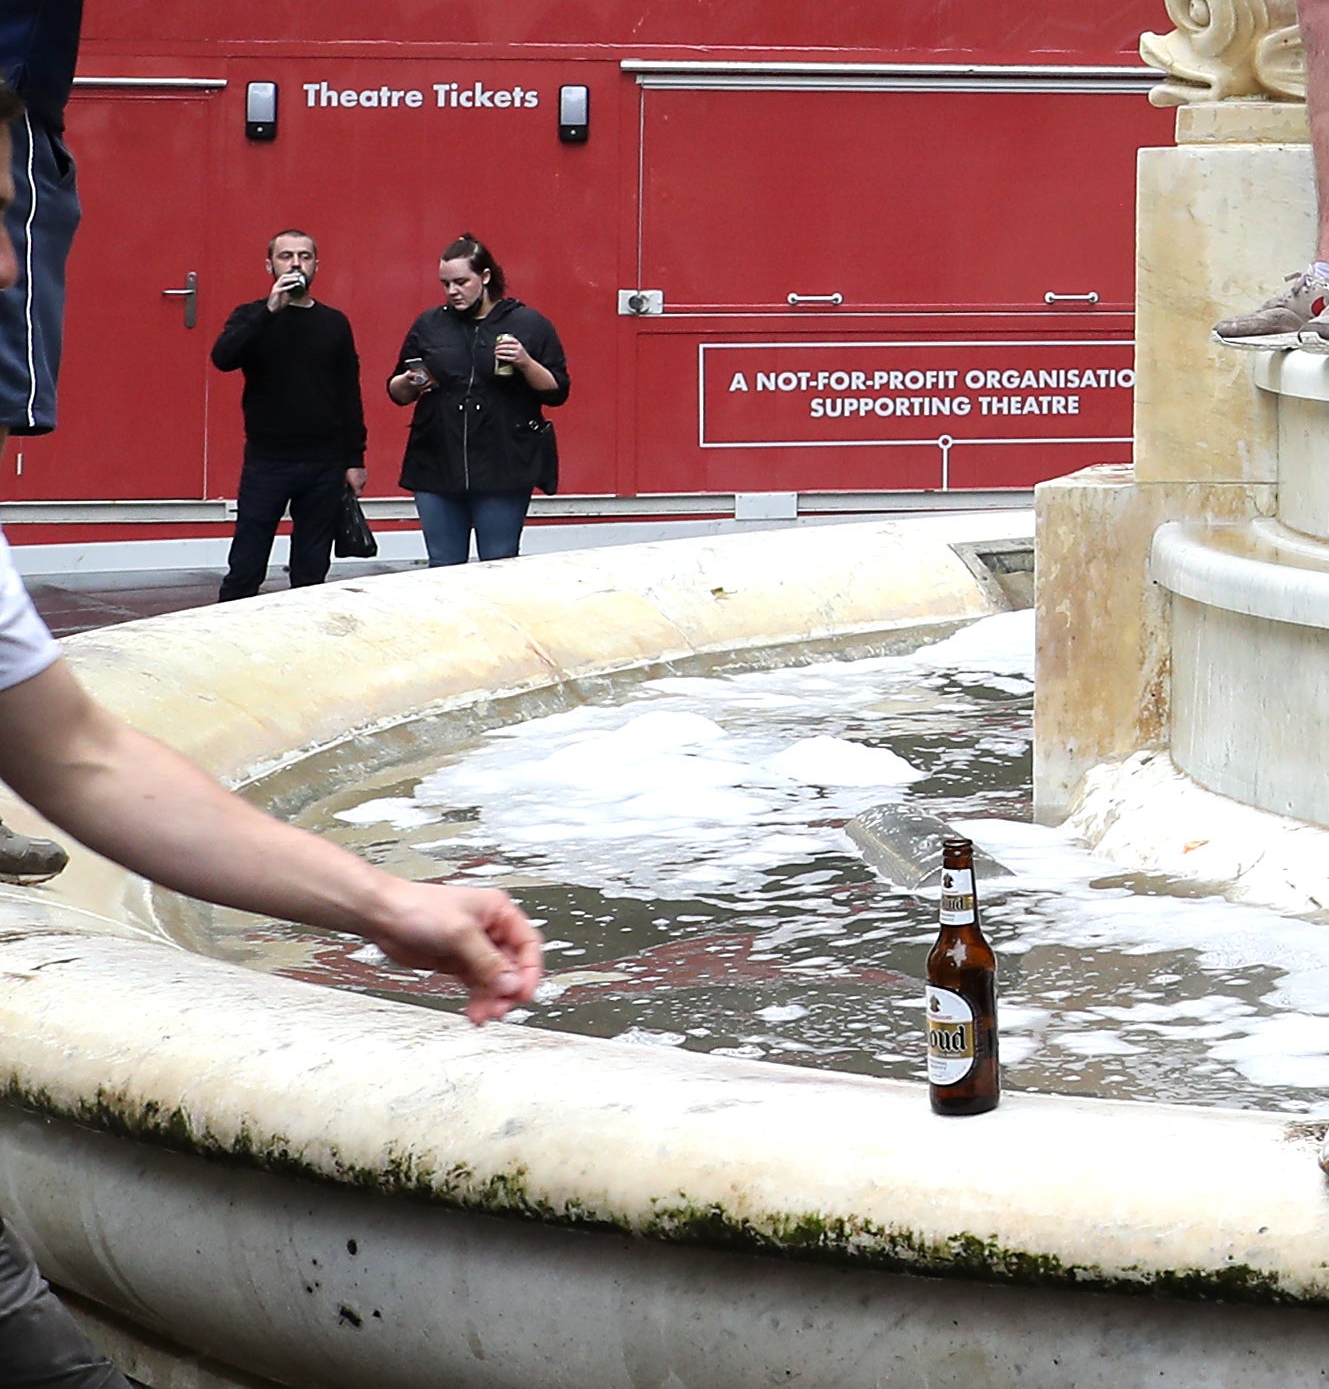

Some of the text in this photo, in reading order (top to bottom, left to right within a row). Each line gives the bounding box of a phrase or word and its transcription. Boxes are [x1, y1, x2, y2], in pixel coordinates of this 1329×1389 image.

[302, 81, 540, 109] Theatre Tickets
[729, 369, 1136, 393] A NOT-FOR-PROFIT ORGANISATIO
[810, 395, 1080, 418] SUPPORTING THEATRE
[930, 1024, 968, 1052] oud
